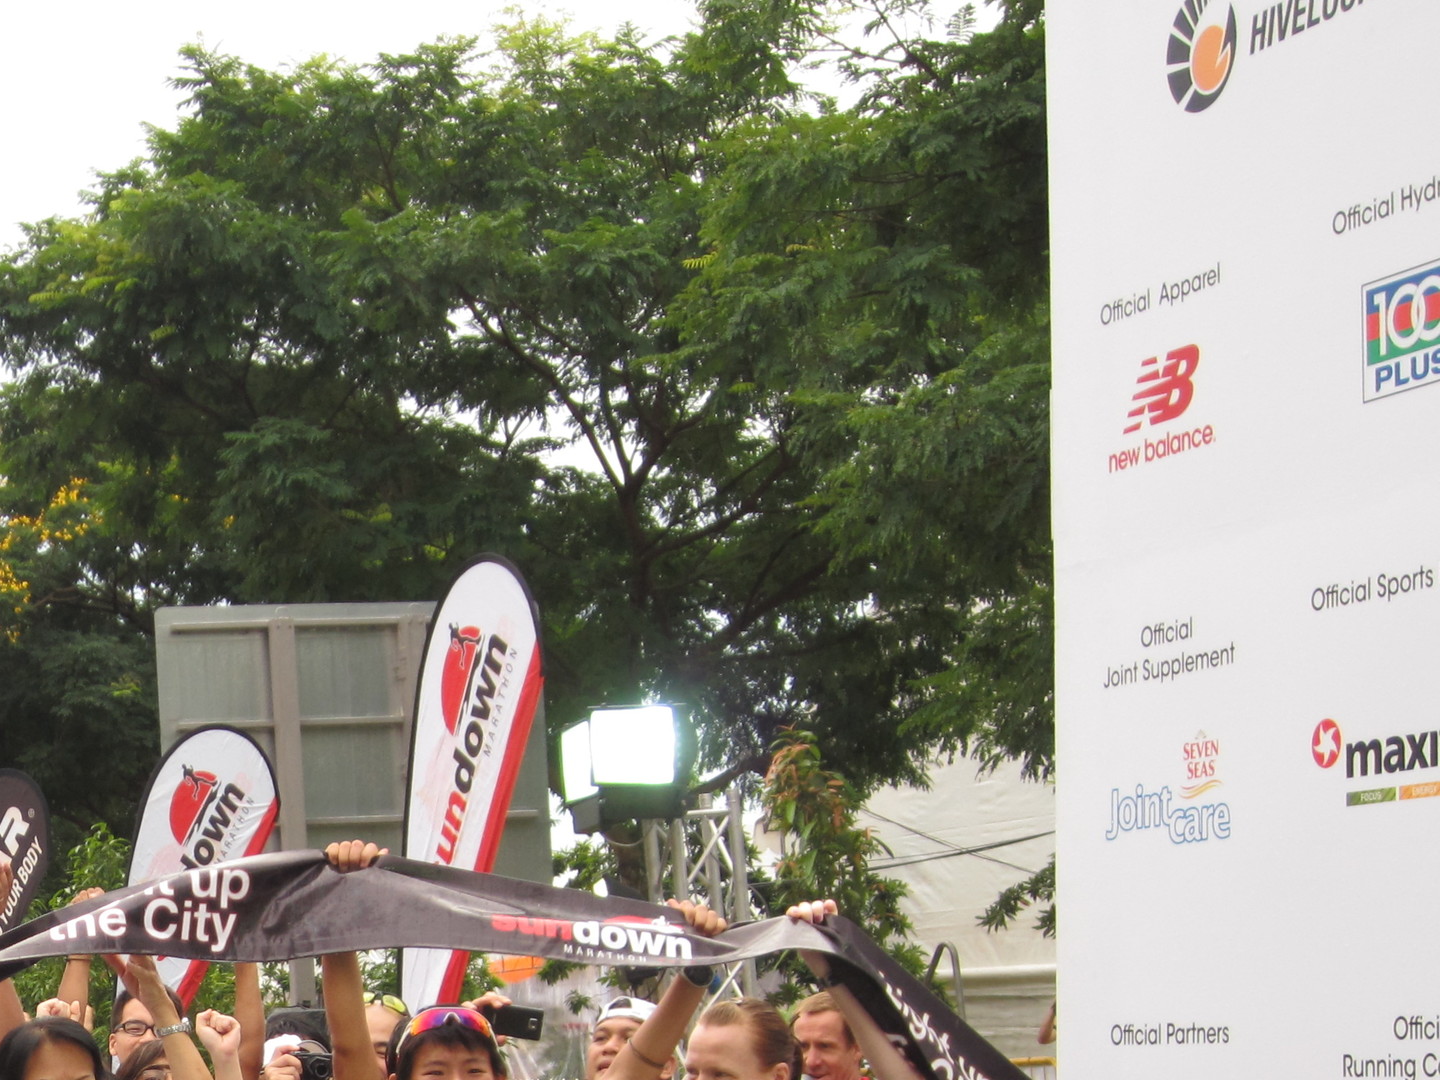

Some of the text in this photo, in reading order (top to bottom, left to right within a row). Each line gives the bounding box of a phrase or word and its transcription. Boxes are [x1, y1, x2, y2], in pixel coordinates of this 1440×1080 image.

[1249, 0, 1364, 56] HIVELO
[1332, 191, 1395, 236] Official
[1100, 262, 1221, 326] Official Apparel
[1108, 445, 1141, 474] new
[1311, 565, 1434, 611] Official Sports
[1140, 616, 1193, 648] Official
[1103, 641, 1236, 689] Joint Supplement
[482, 647, 519, 758] MARATHON
[434, 633, 509, 867] undown
[1183, 739, 1220, 761] SEVEN
[1187, 759, 1217, 780] SEAS
[16, 835, 44, 887] BODY
[190, 868, 251, 910] up
[143, 897, 238, 953] City
[563, 943, 648, 964] MARATHON
[1110, 1022, 1230, 1047] Official Partners
[1422, 1052, 1440, 1078] C
